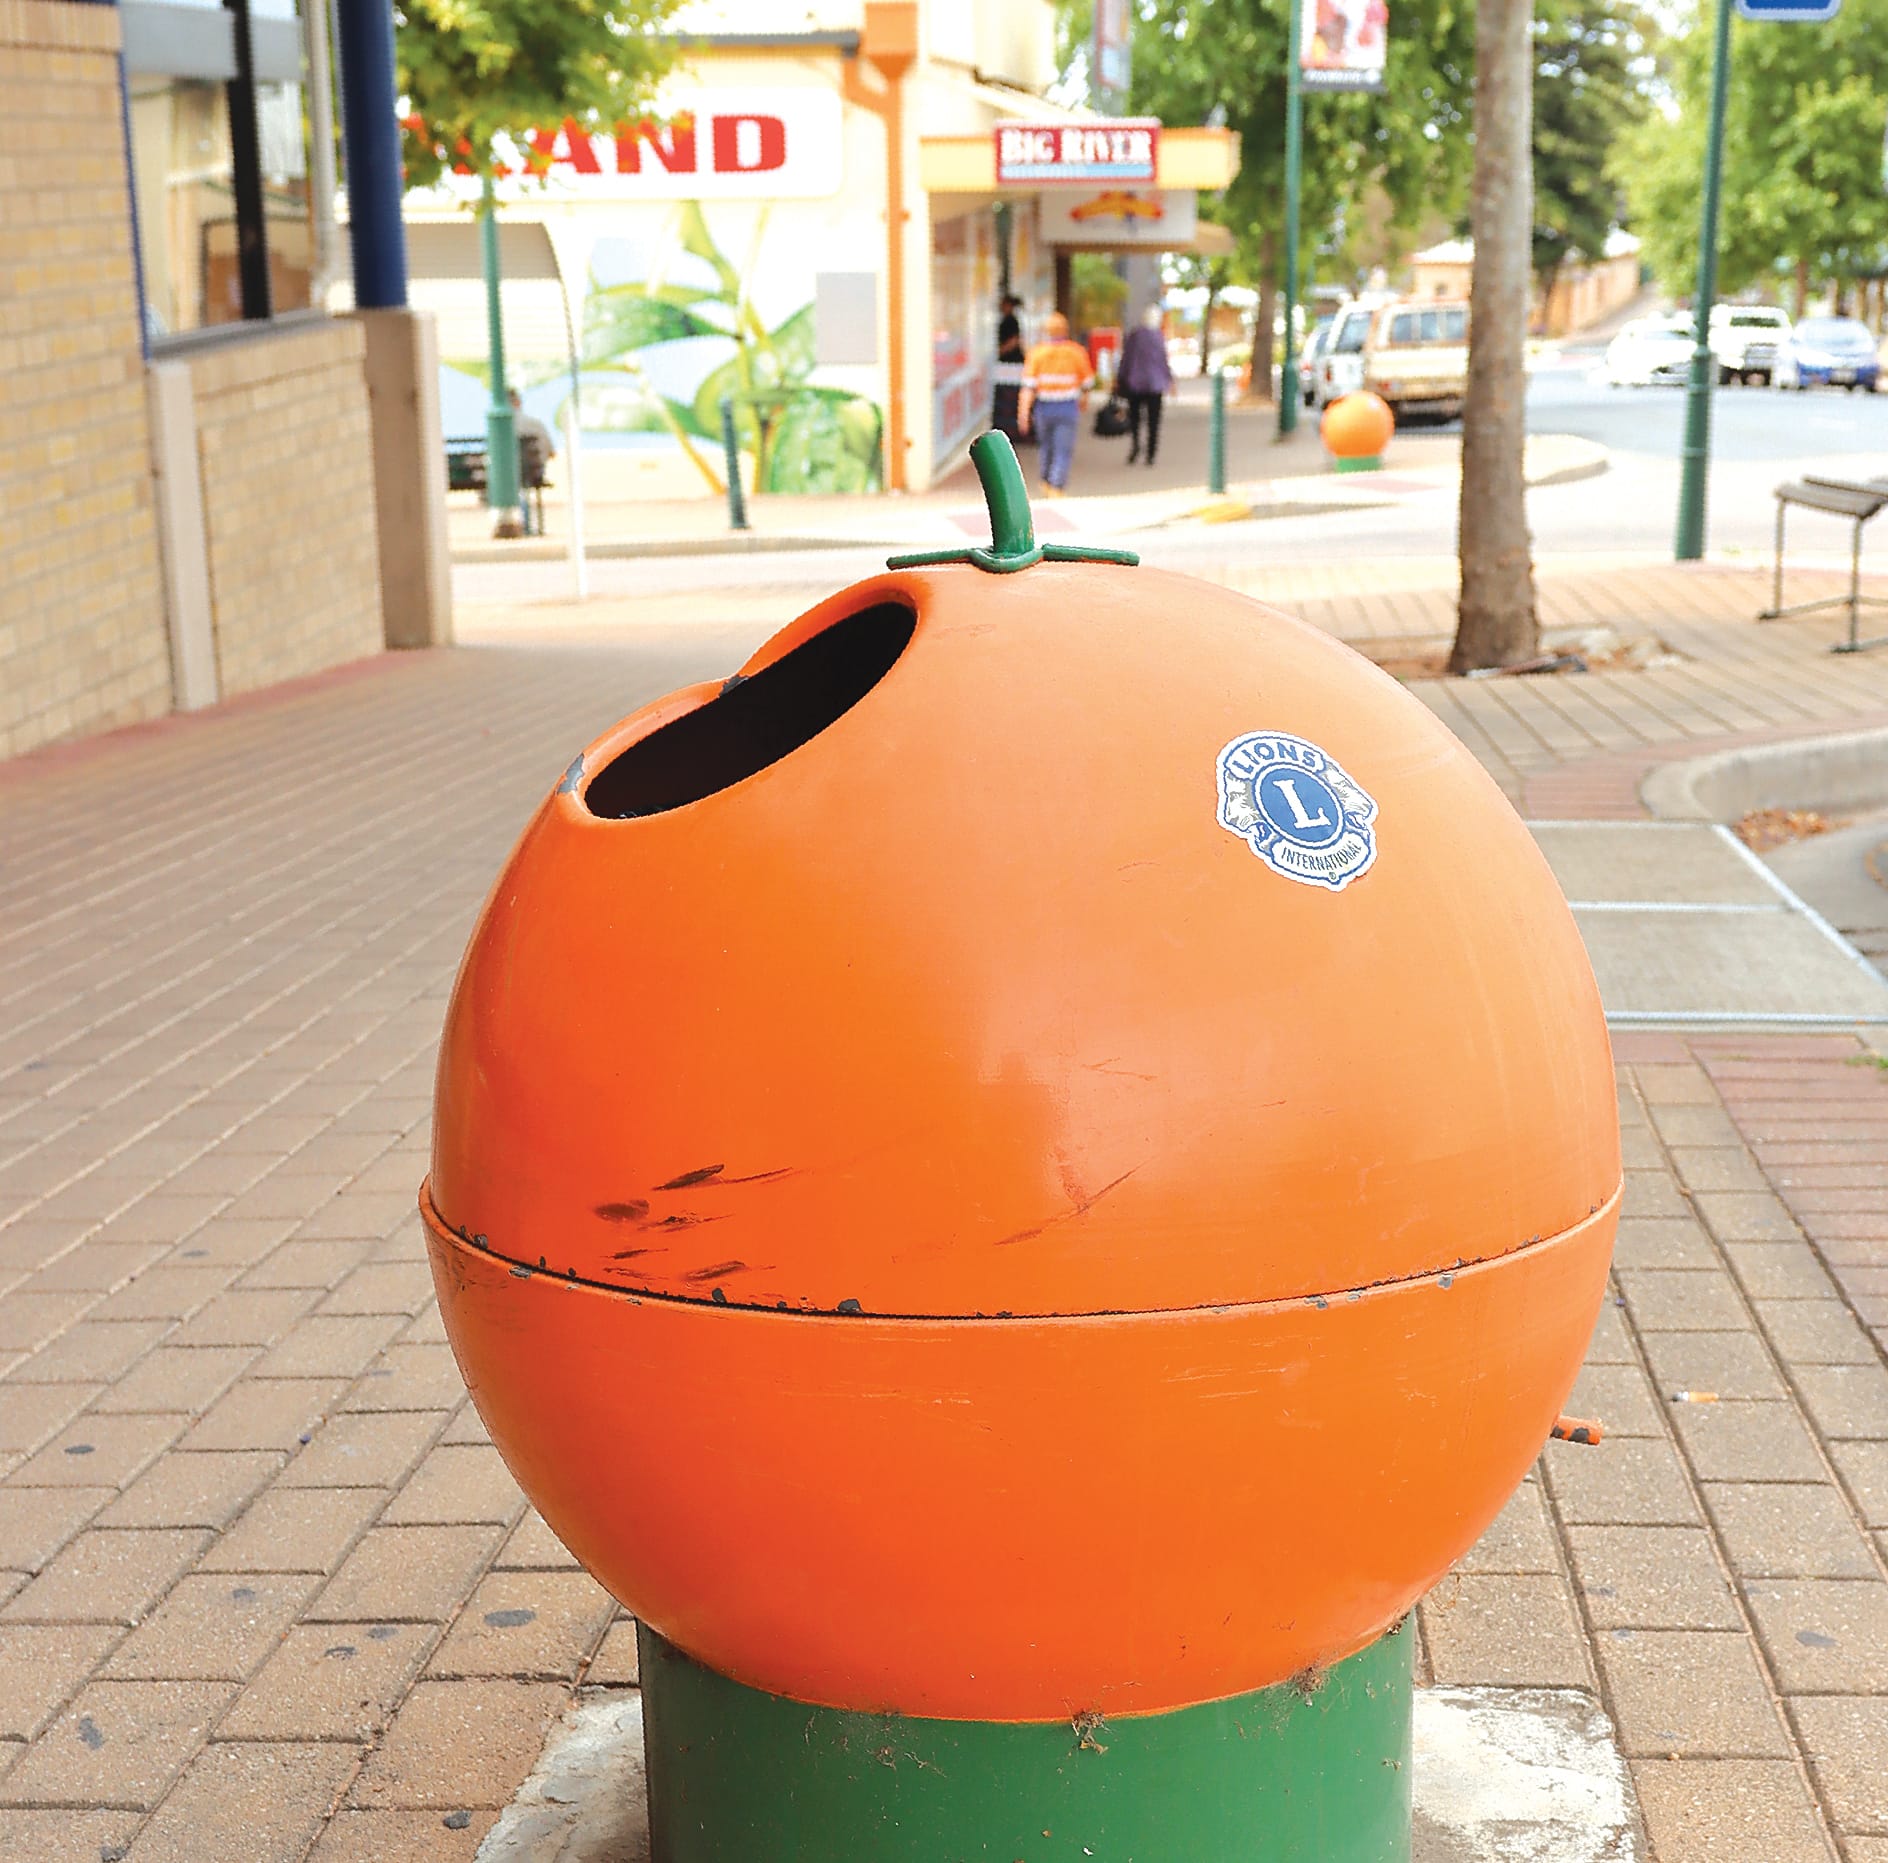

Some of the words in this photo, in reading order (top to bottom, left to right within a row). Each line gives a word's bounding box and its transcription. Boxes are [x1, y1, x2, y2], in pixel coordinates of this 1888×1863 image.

[1002, 127, 1054, 164] BIG
[1232, 741, 1317, 774] LIONS
[1272, 778, 1332, 829] L
[1281, 840, 1362, 871] INTERNATIONAL
